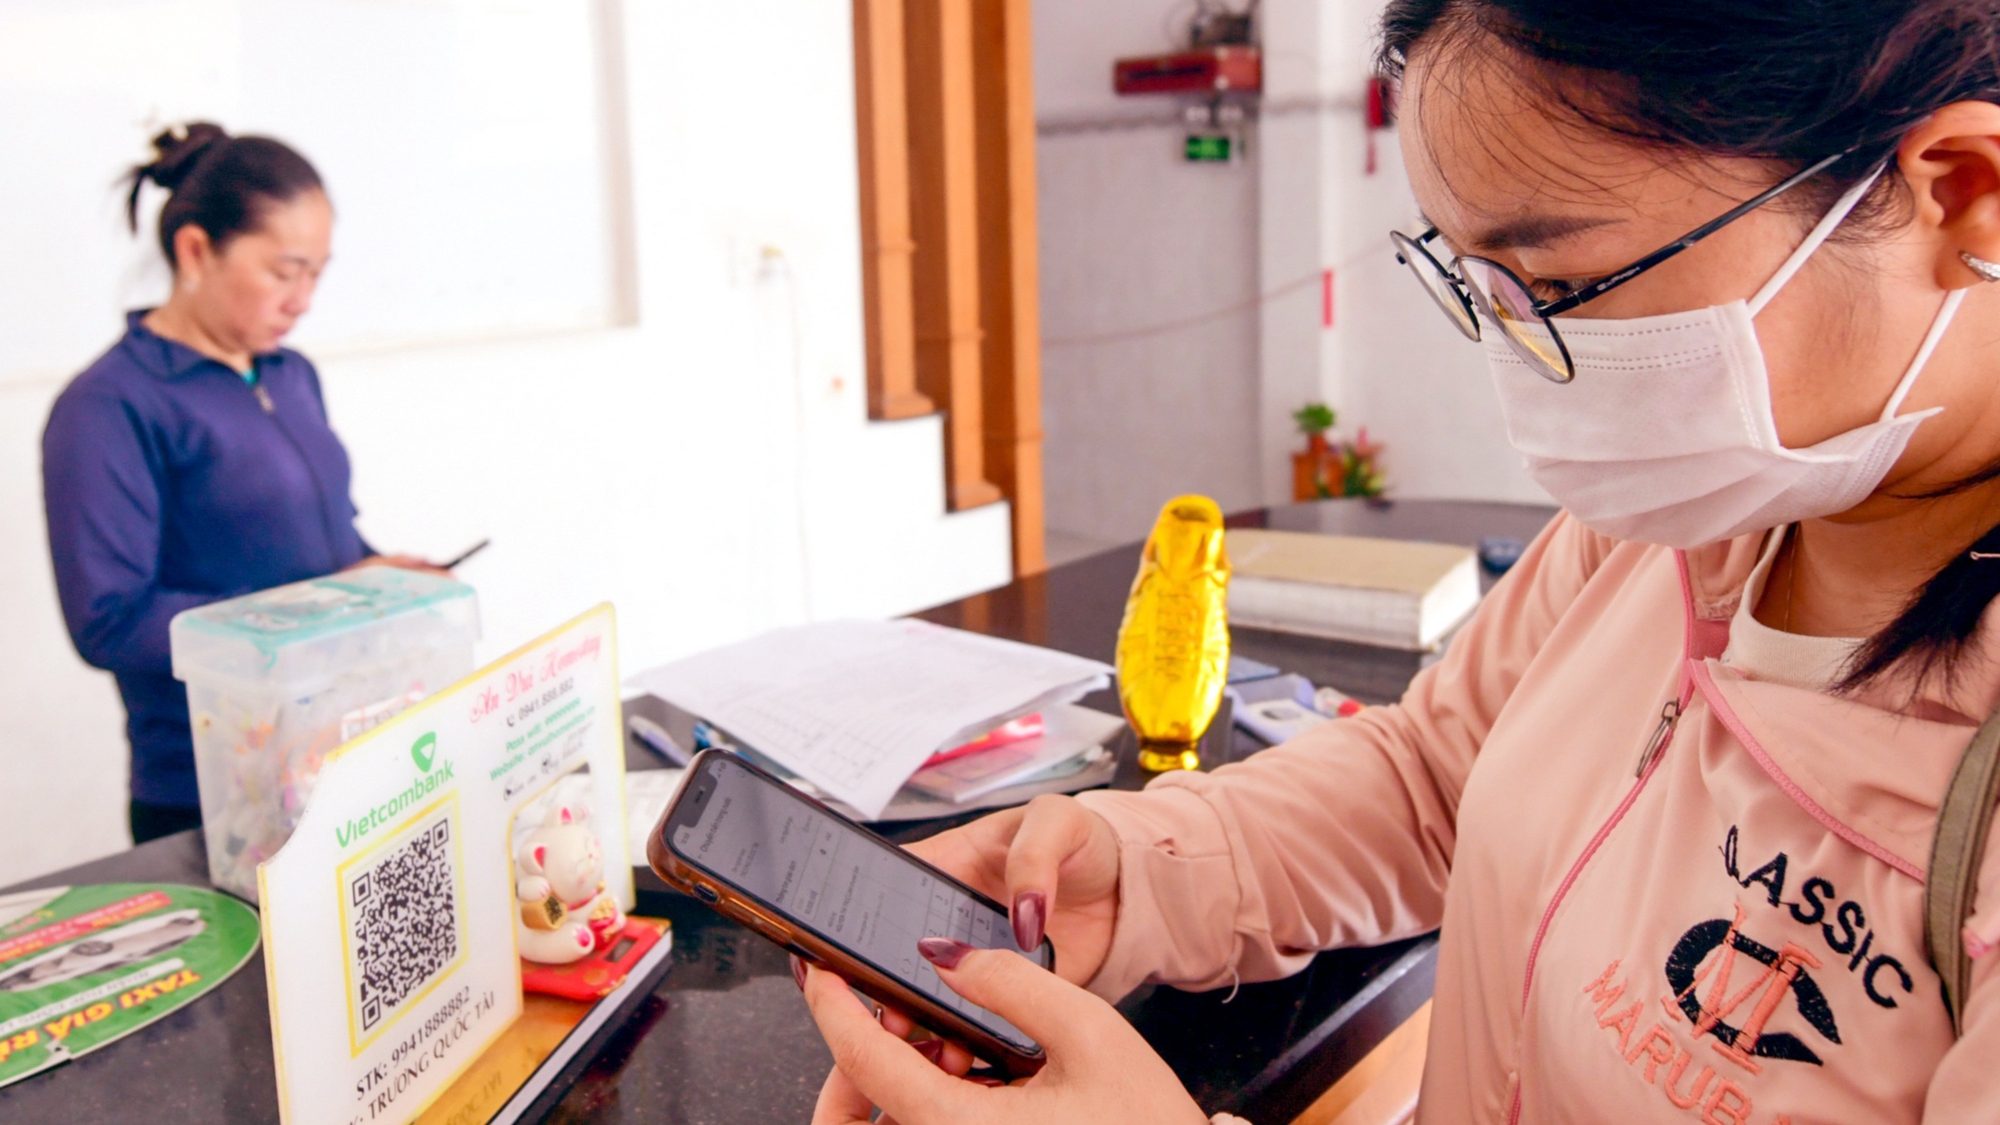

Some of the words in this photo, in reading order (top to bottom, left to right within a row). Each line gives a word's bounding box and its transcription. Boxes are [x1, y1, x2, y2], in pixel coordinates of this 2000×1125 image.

[335, 760, 455, 849] Vietcombank
[117, 968, 202, 1011] TAXI
[1583, 959, 1793, 1125] MARUB
[356, 1062, 388, 1101] STK:
